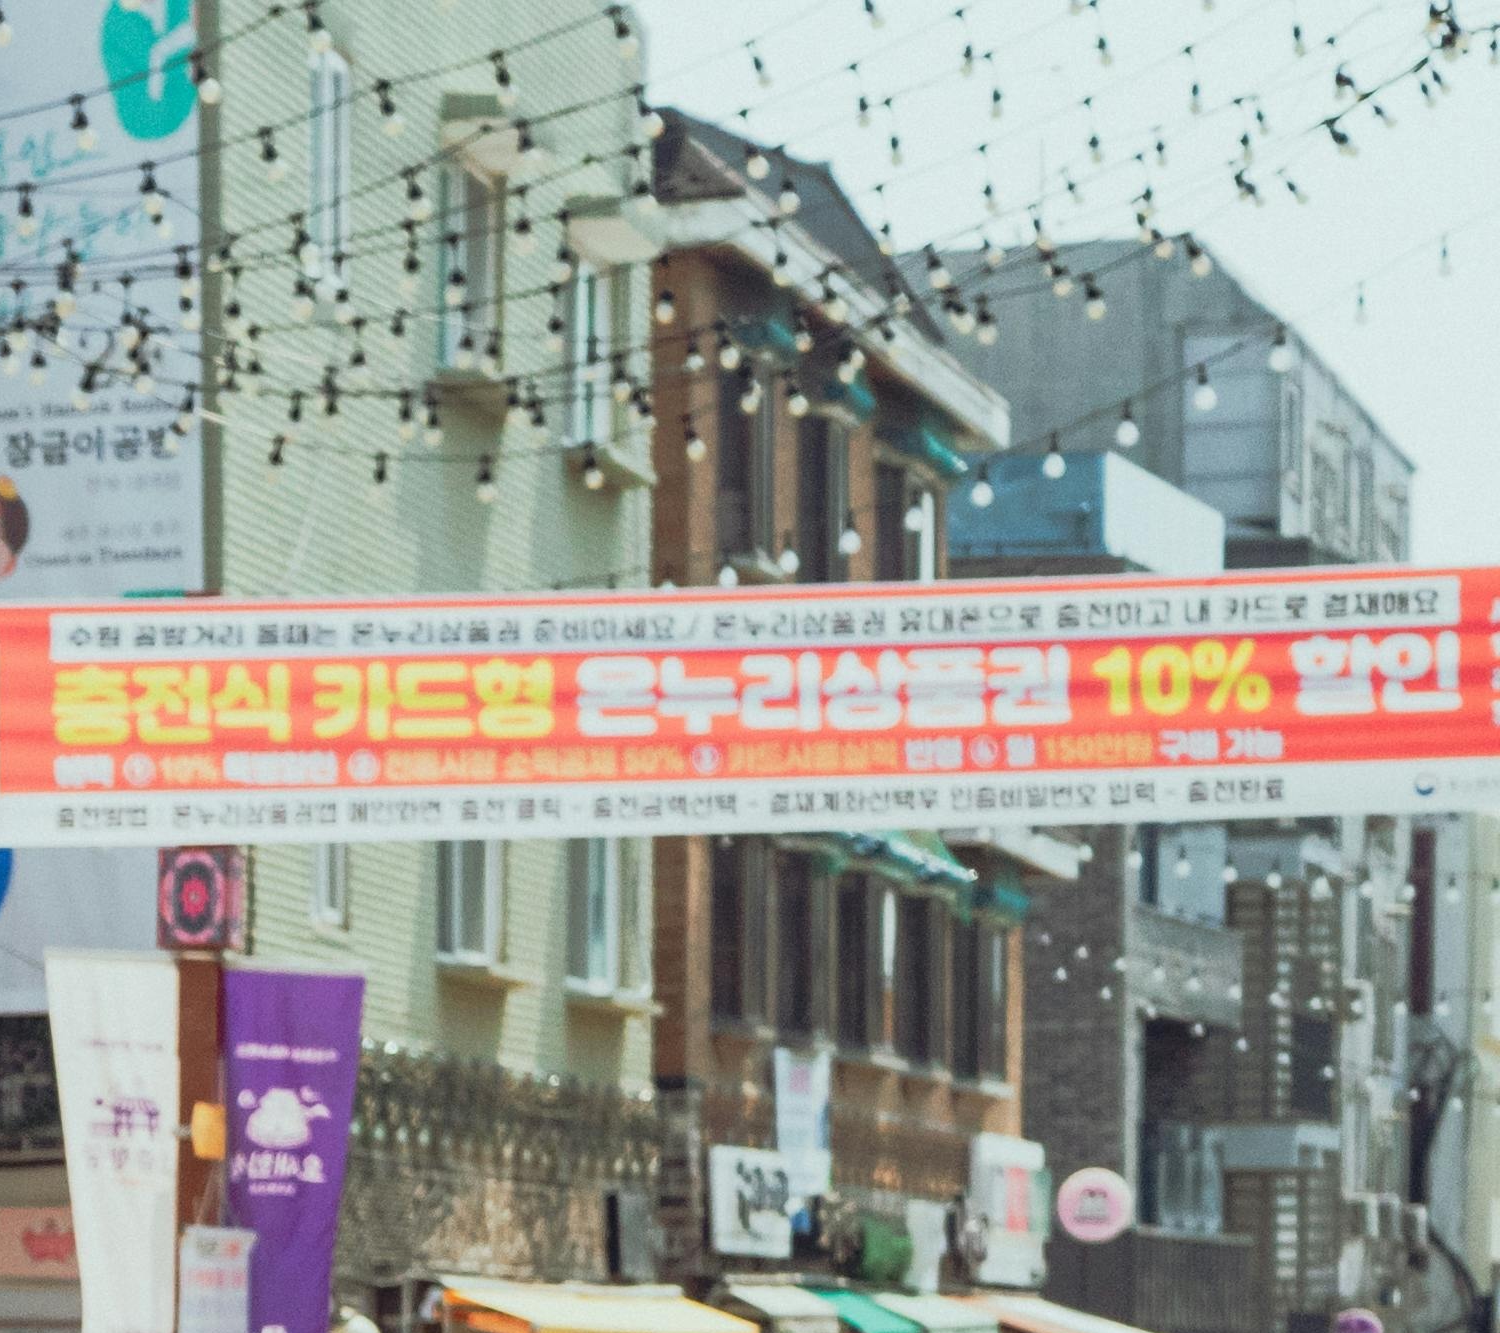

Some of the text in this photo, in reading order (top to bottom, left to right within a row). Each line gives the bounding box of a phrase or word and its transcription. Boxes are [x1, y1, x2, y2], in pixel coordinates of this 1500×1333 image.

[1183, 598, 1211, 624] 내
[1222, 596, 1307, 622] 카드로
[52, 663, 292, 746] 충전식
[311, 657, 556, 742] 카드형
[575, 644, 1073, 738] 온누리상품권
[1093, 639, 1272, 717] 10%
[1289, 631, 1464, 716] 할인
